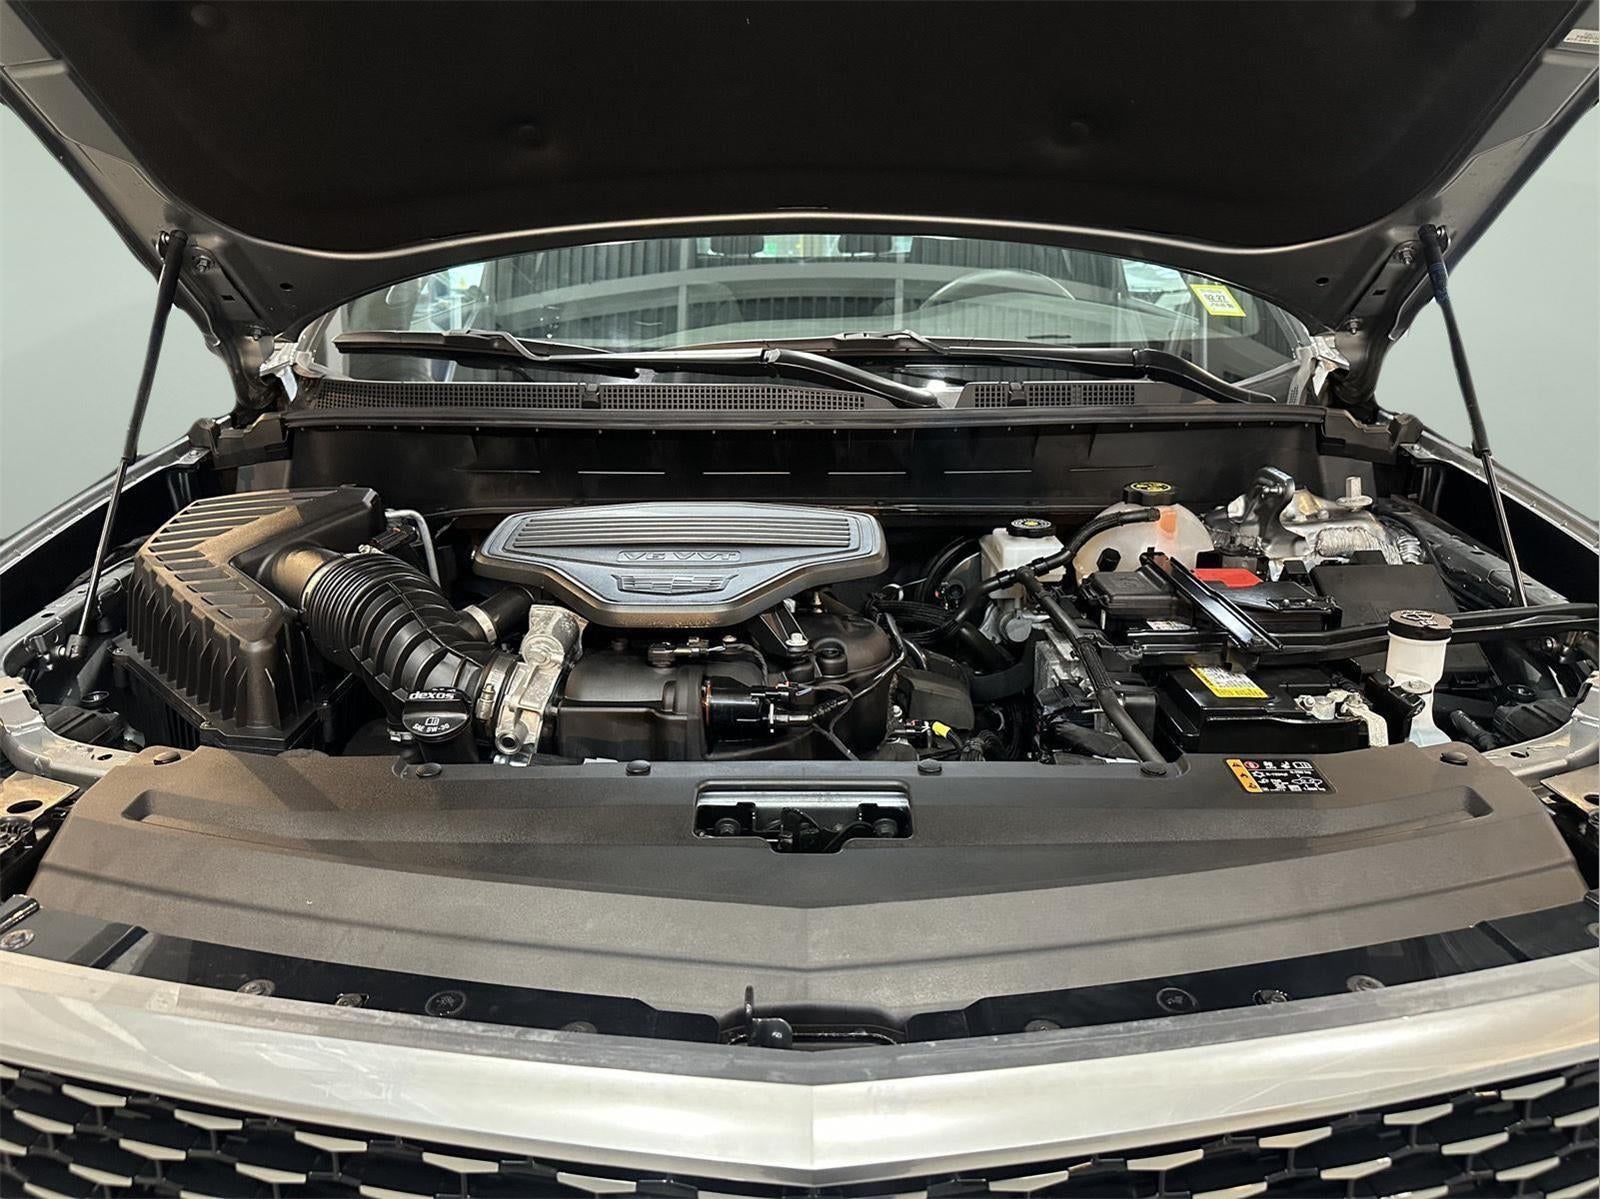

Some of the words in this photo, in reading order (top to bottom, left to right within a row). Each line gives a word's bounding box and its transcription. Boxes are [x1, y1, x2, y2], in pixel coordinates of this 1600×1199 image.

[624, 551, 665, 561] V6
[673, 551, 738, 561] VVT
[409, 690, 455, 700] dexos
